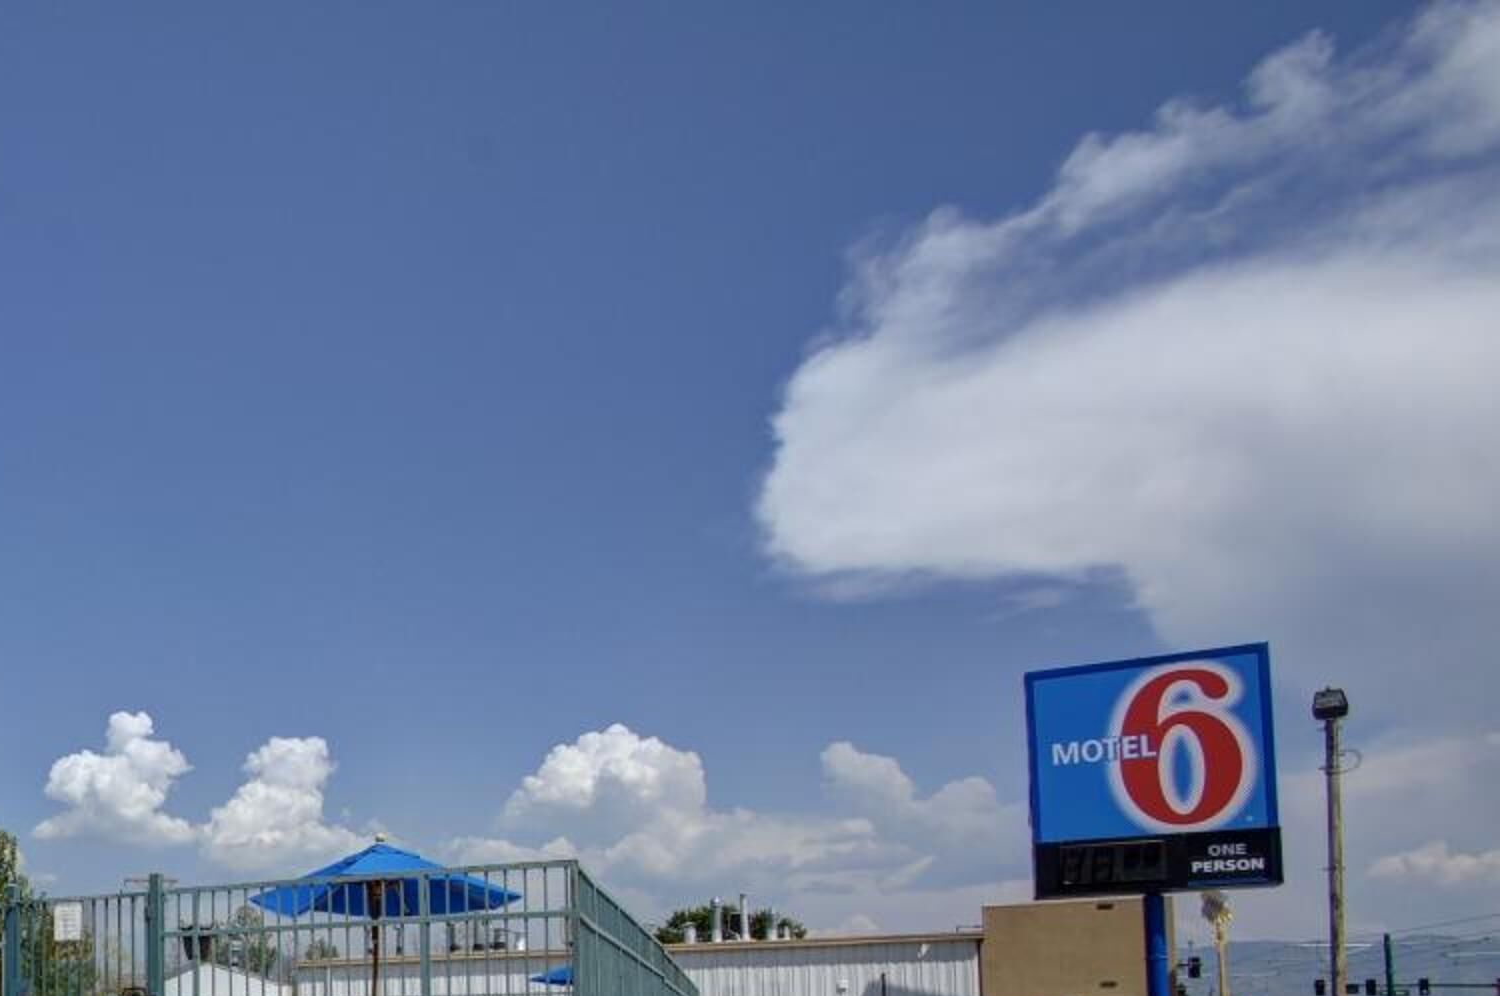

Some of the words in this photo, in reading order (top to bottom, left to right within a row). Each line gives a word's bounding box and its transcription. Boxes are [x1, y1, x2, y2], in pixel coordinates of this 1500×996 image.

[1051, 734, 1157, 766] MOTEL
[1113, 664, 1251, 829] 6
[1207, 843, 1249, 857] ONE
[1190, 857, 1266, 873] PERSON
